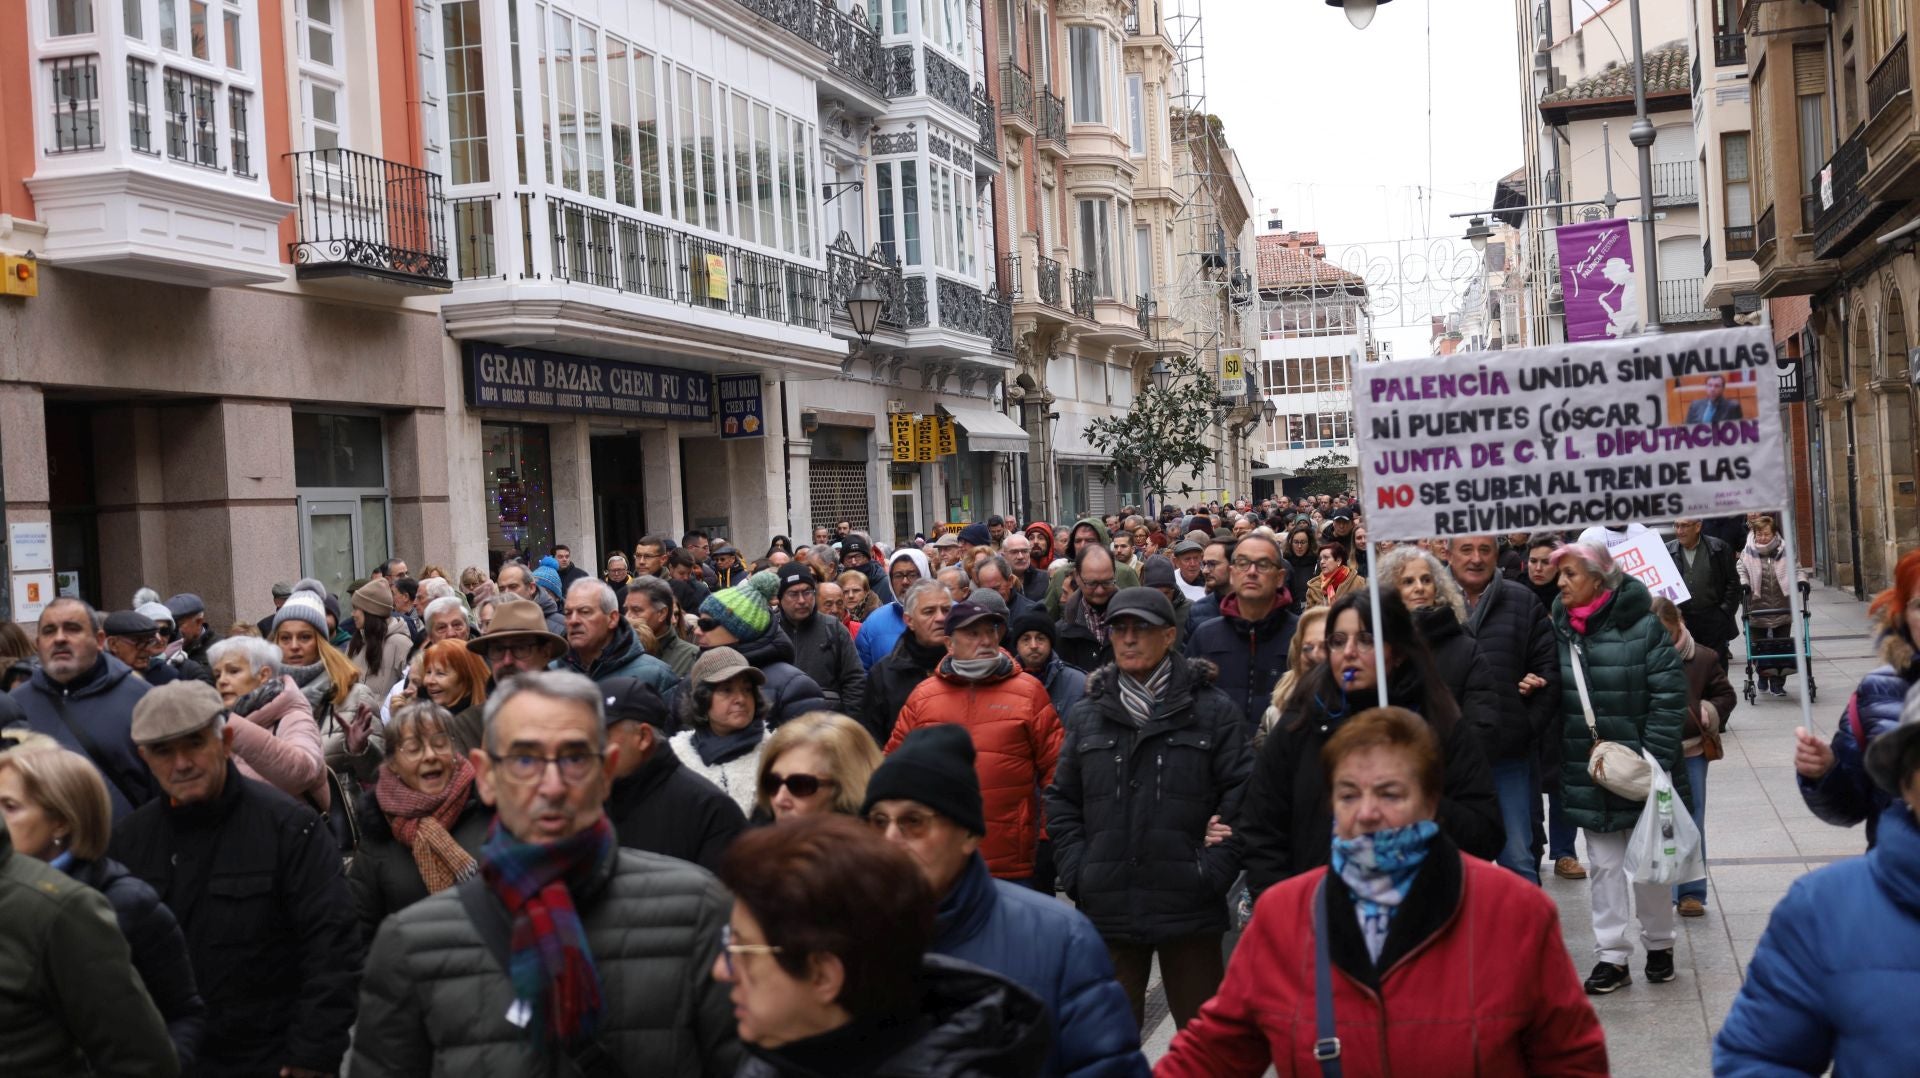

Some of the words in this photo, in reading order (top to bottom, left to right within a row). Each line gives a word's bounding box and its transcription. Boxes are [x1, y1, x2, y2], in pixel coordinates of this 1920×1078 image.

[1581, 254, 1604, 279] PALENCIA
[480, 353, 536, 386] GRAN
[542, 360, 603, 392] BAZAR
[609, 368, 653, 397] CHEN
[661, 374, 680, 399] FU
[1225, 357, 1239, 375] isp
[1370, 365, 1510, 402] PALENCIA
[1519, 357, 1609, 392] UNIDA
[1617, 348, 1663, 382] SIN
[1667, 342, 1769, 376] VALLAS
[481, 386, 498, 401] ROPA
[502, 388, 525, 403] BOLSOS
[529, 390, 554, 405] REGALOS
[720, 380, 737, 399] GRAN
[738, 378, 759, 398] BAZAR
[725, 400, 744, 413] CHEN
[746, 399, 756, 412] FU
[919, 416, 931, 444] COMPRO
[1372, 409, 1400, 439] NI
[1409, 406, 1529, 437] PUENTES
[919, 446, 931, 460] ORO
[1374, 446, 1462, 475] JUNTA
[1471, 442, 1504, 468] DE
[1541, 438, 1557, 460] Y
[1377, 484, 1414, 509] NO
[1419, 481, 1451, 505] SE
[1455, 473, 1542, 502] SUBEN
[1548, 469, 1581, 495] AL
[1585, 464, 1653, 492] TREN
[1658, 462, 1691, 485] DE
[1700, 456, 1751, 482] LAS
[1435, 491, 1684, 534] REIVINDICACIONES
